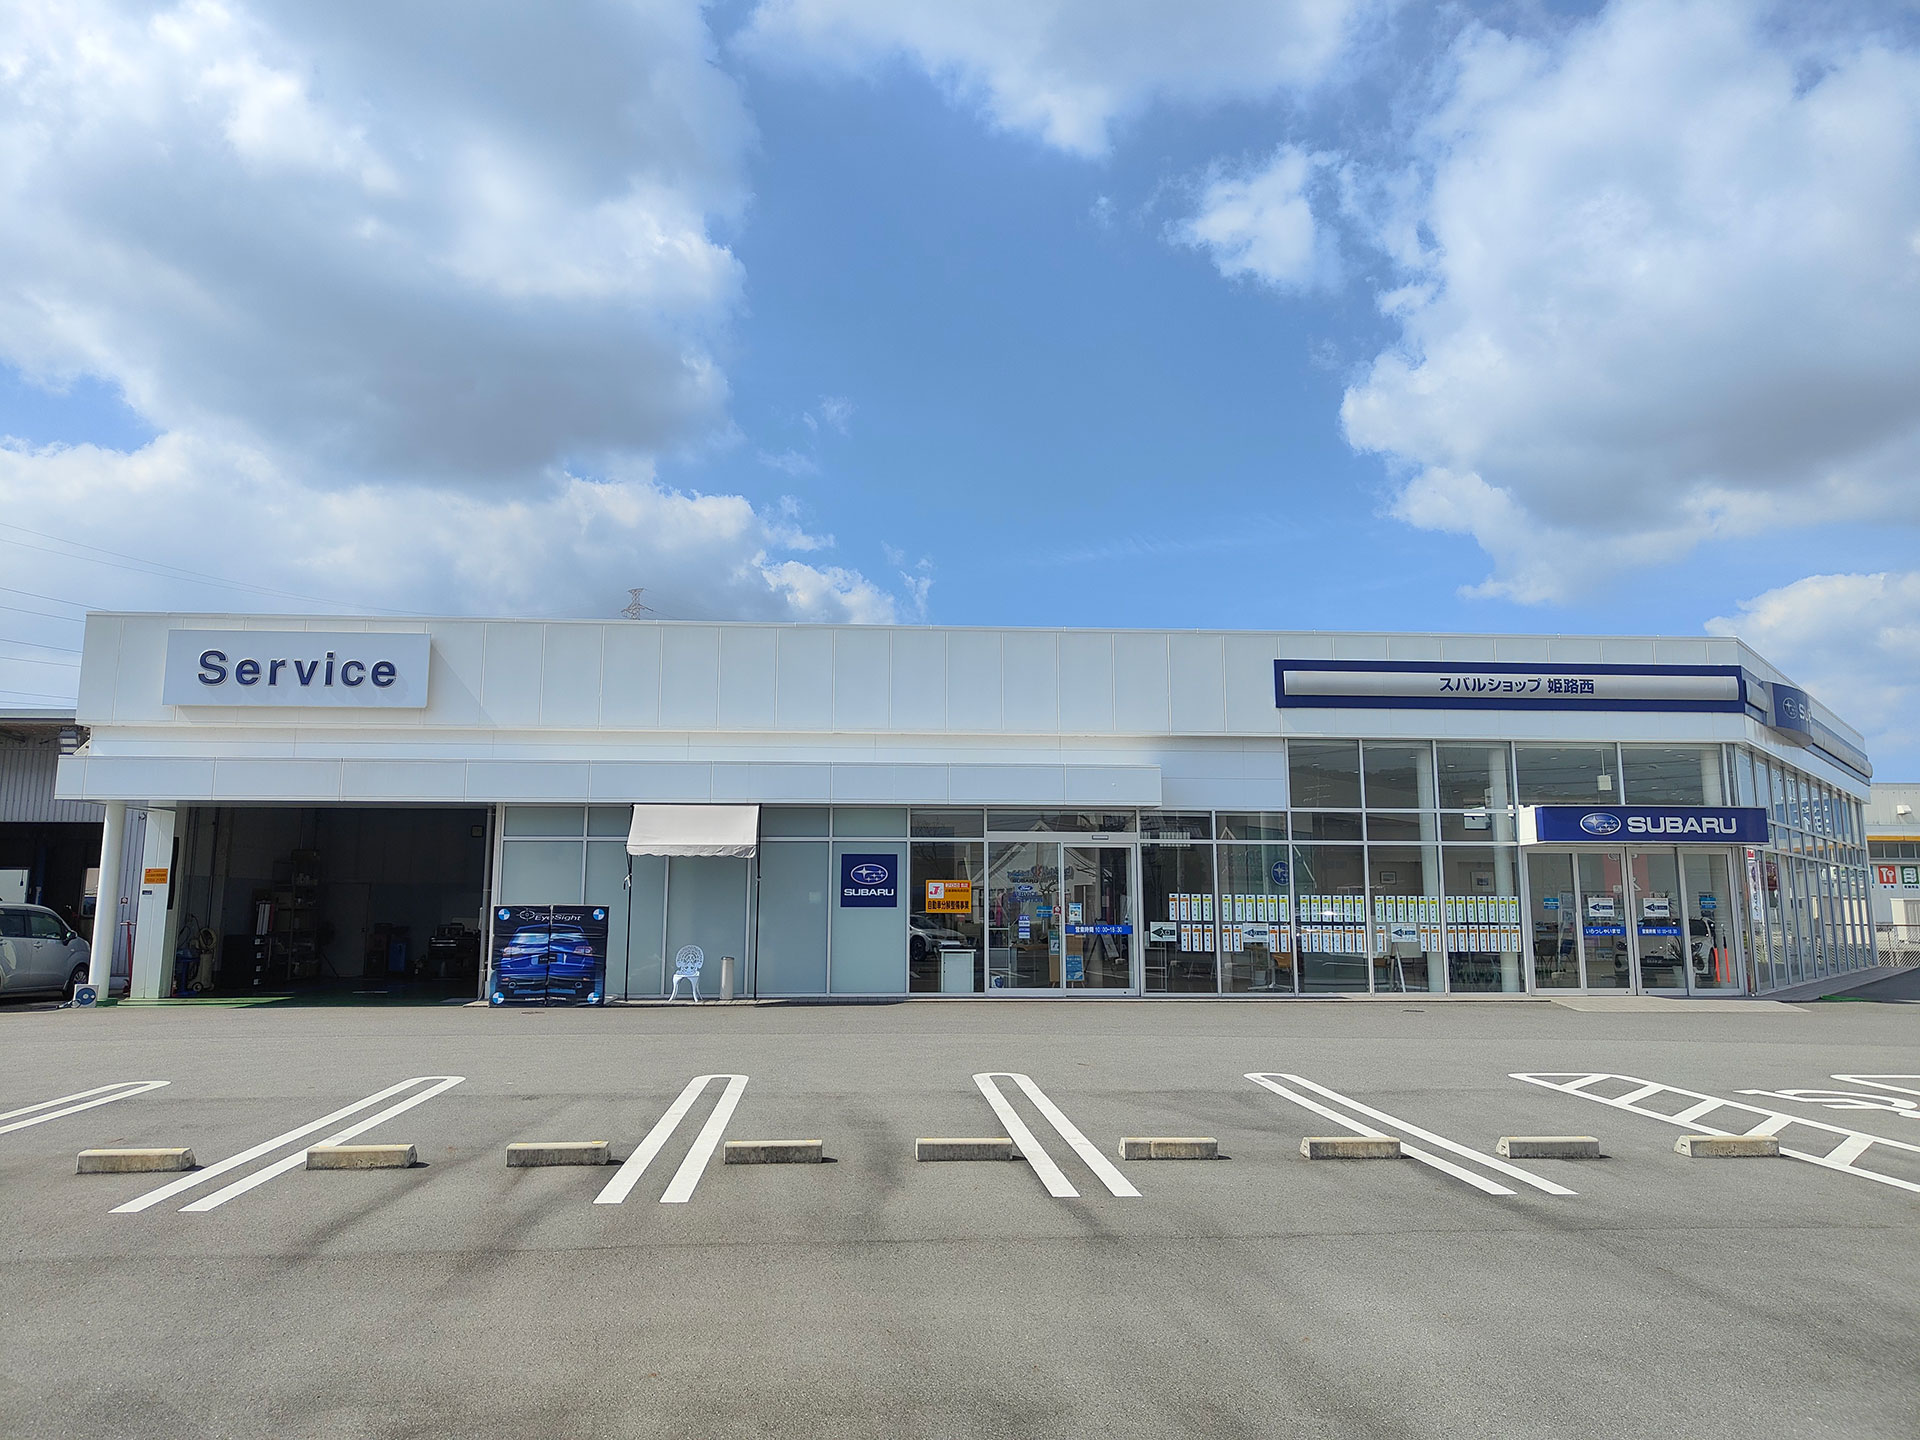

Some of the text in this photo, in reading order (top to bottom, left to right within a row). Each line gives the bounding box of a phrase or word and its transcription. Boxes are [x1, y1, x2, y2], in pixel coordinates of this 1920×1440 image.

[198, 649, 397, 687] Service
[1439, 677, 1595, 695] スバルショップ 姫路西
[1627, 816, 1737, 834] SUBARU
[844, 888, 894, 896] SUBARU
